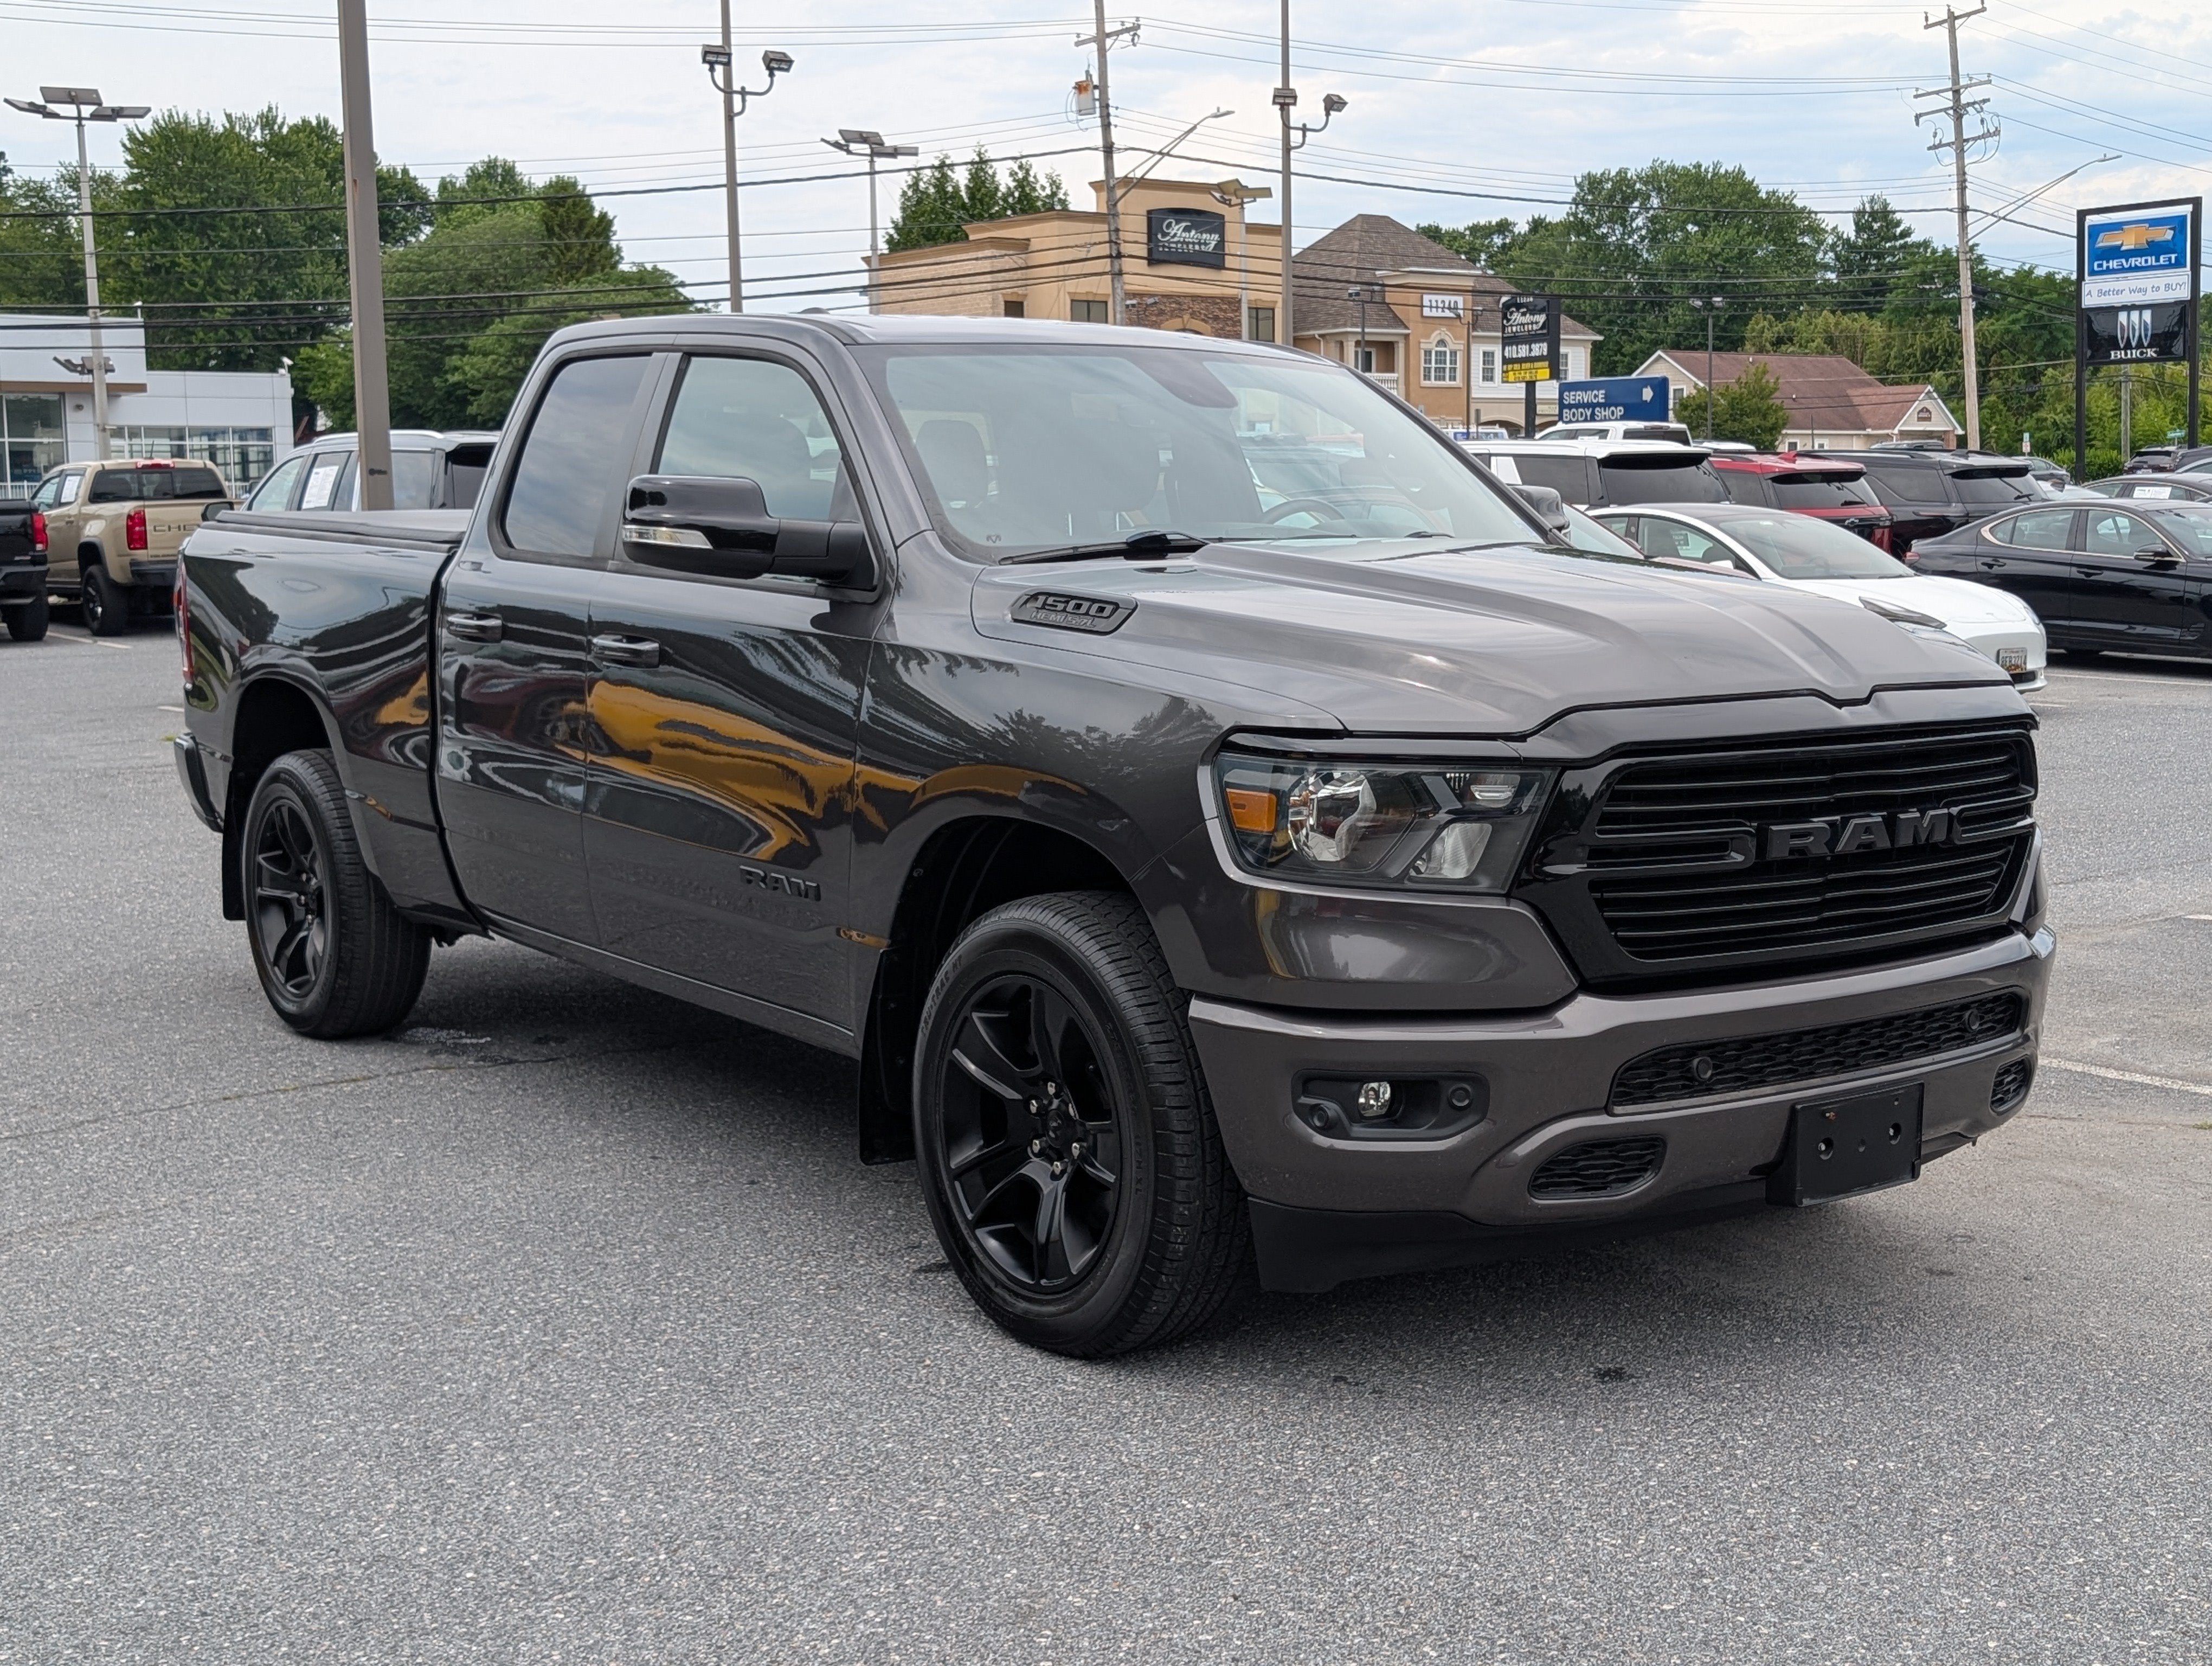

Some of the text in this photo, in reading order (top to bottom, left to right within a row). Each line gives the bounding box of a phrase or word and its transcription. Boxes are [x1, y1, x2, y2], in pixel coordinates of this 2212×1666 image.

[2094, 253, 2178, 271] CHEVROLET
[2097, 289, 2125, 297] Better
[2129, 286, 2147, 296] Way
[2151, 284, 2160, 293] to
[2164, 282, 2187, 292] BUY!
[2110, 349, 2157, 360] BUICK
[1563, 389, 1606, 405] SERVICE
[1563, 406, 1624, 422] BODY SHOP
[1027, 595, 1117, 618] 1500
[1031, 611, 1065, 623] HEMI
[1767, 808, 1949, 861] RAM
[740, 865, 821, 902] RAM
